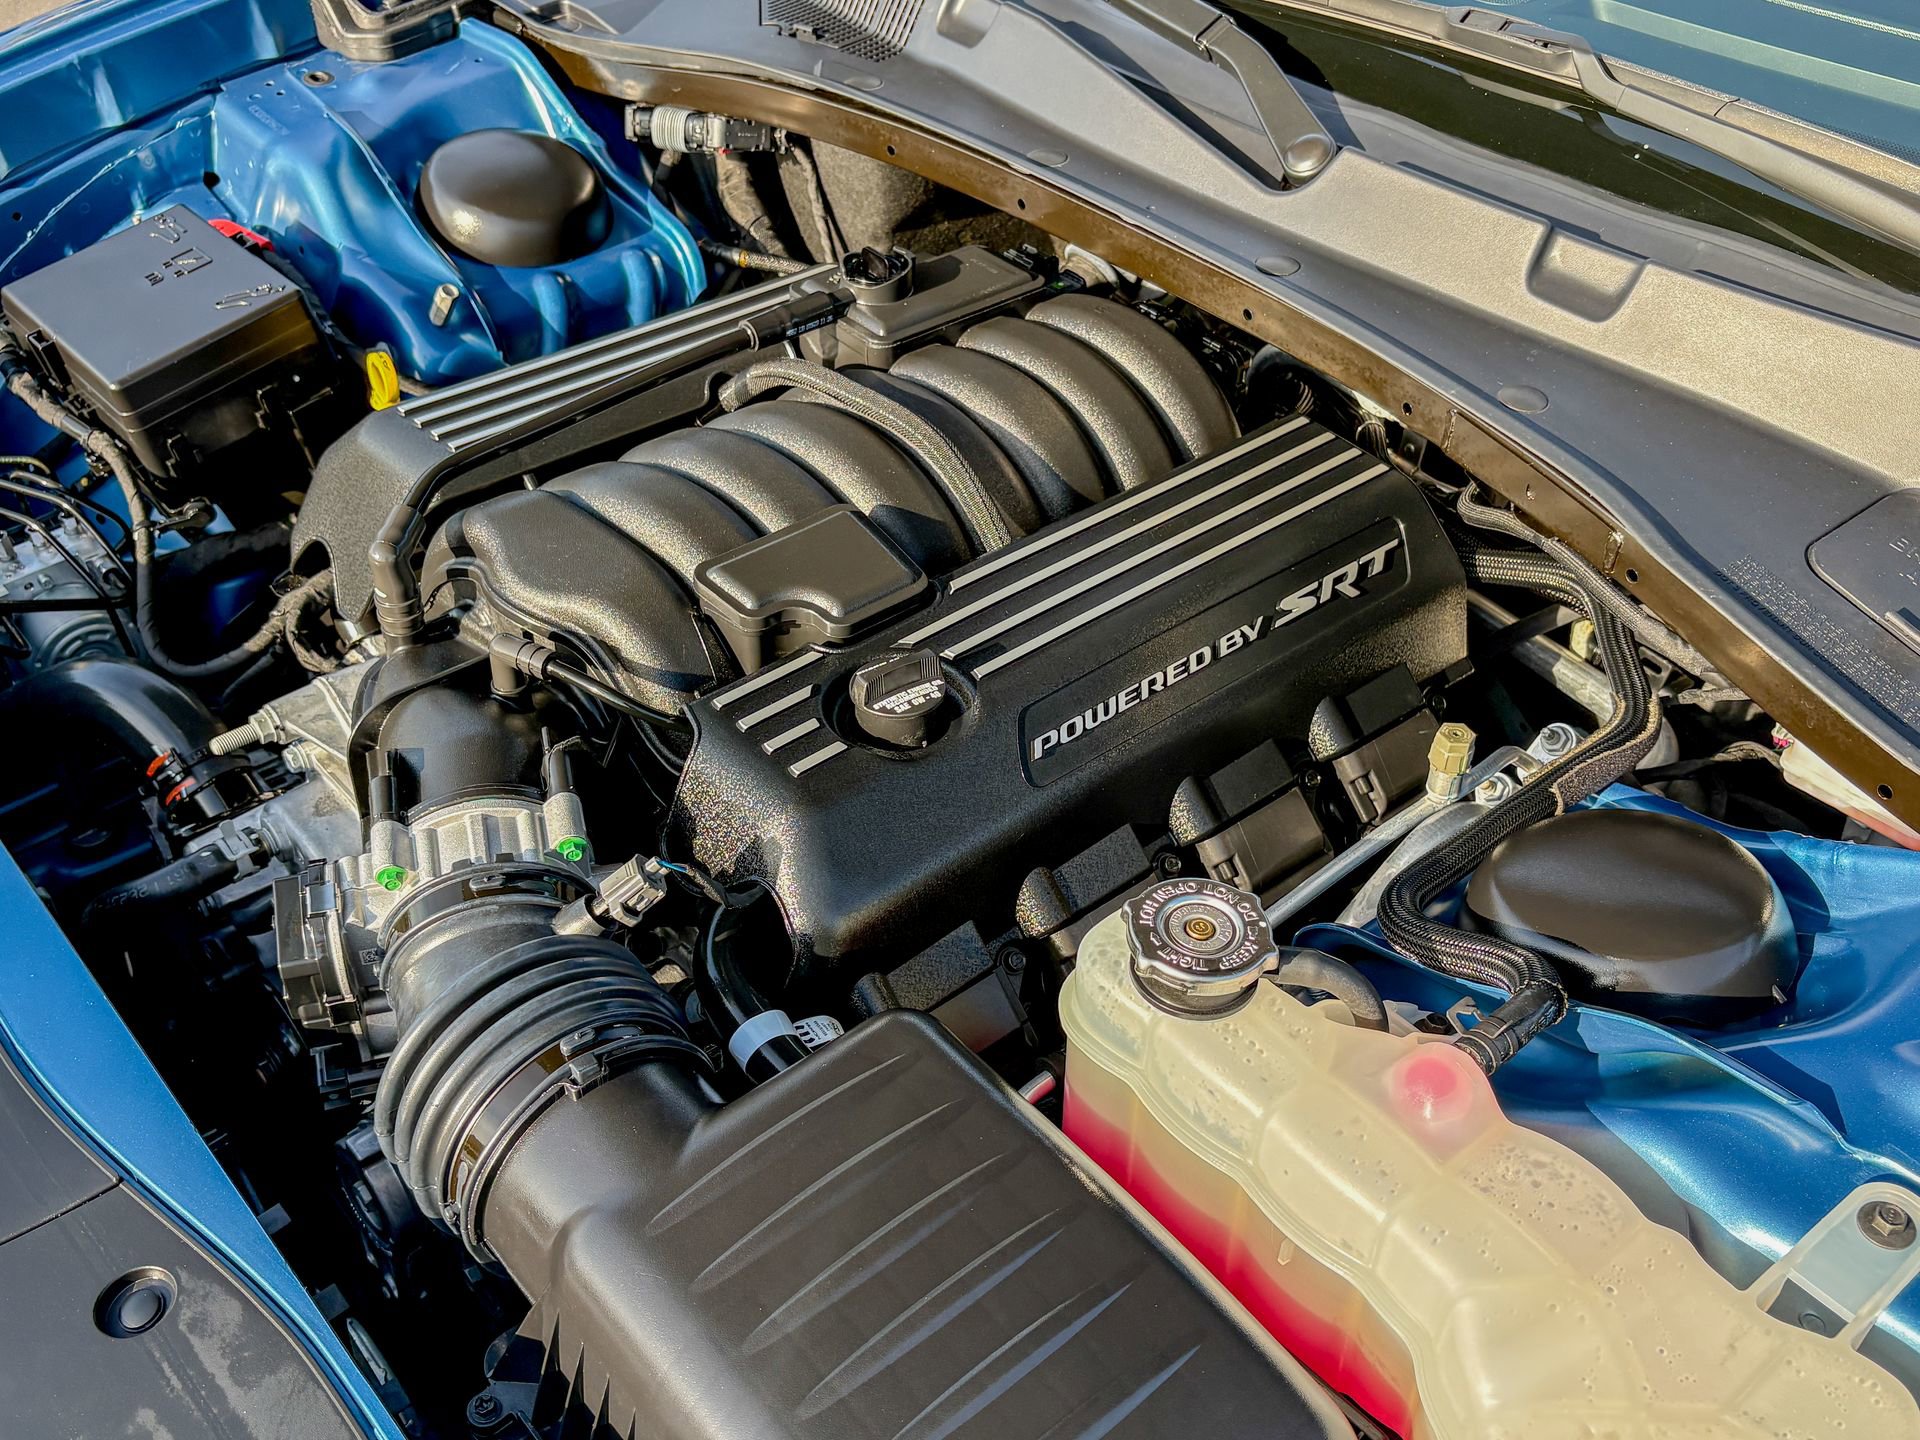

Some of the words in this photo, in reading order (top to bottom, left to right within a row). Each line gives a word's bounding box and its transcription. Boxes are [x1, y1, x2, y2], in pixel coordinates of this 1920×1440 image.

[1031, 645, 1212, 762] POWERED
[1217, 615, 1264, 659] BY
[1272, 538, 1399, 629] SRT
[894, 702, 911, 714] SAE
[1152, 882, 1198, 903] OPEN
[1203, 883, 1240, 904] NOT
[1139, 900, 1159, 927] HOT
[1237, 902, 1259, 922] DO
[1156, 946, 1209, 971] TIGHT
[1219, 941, 1259, 970] KEEP
